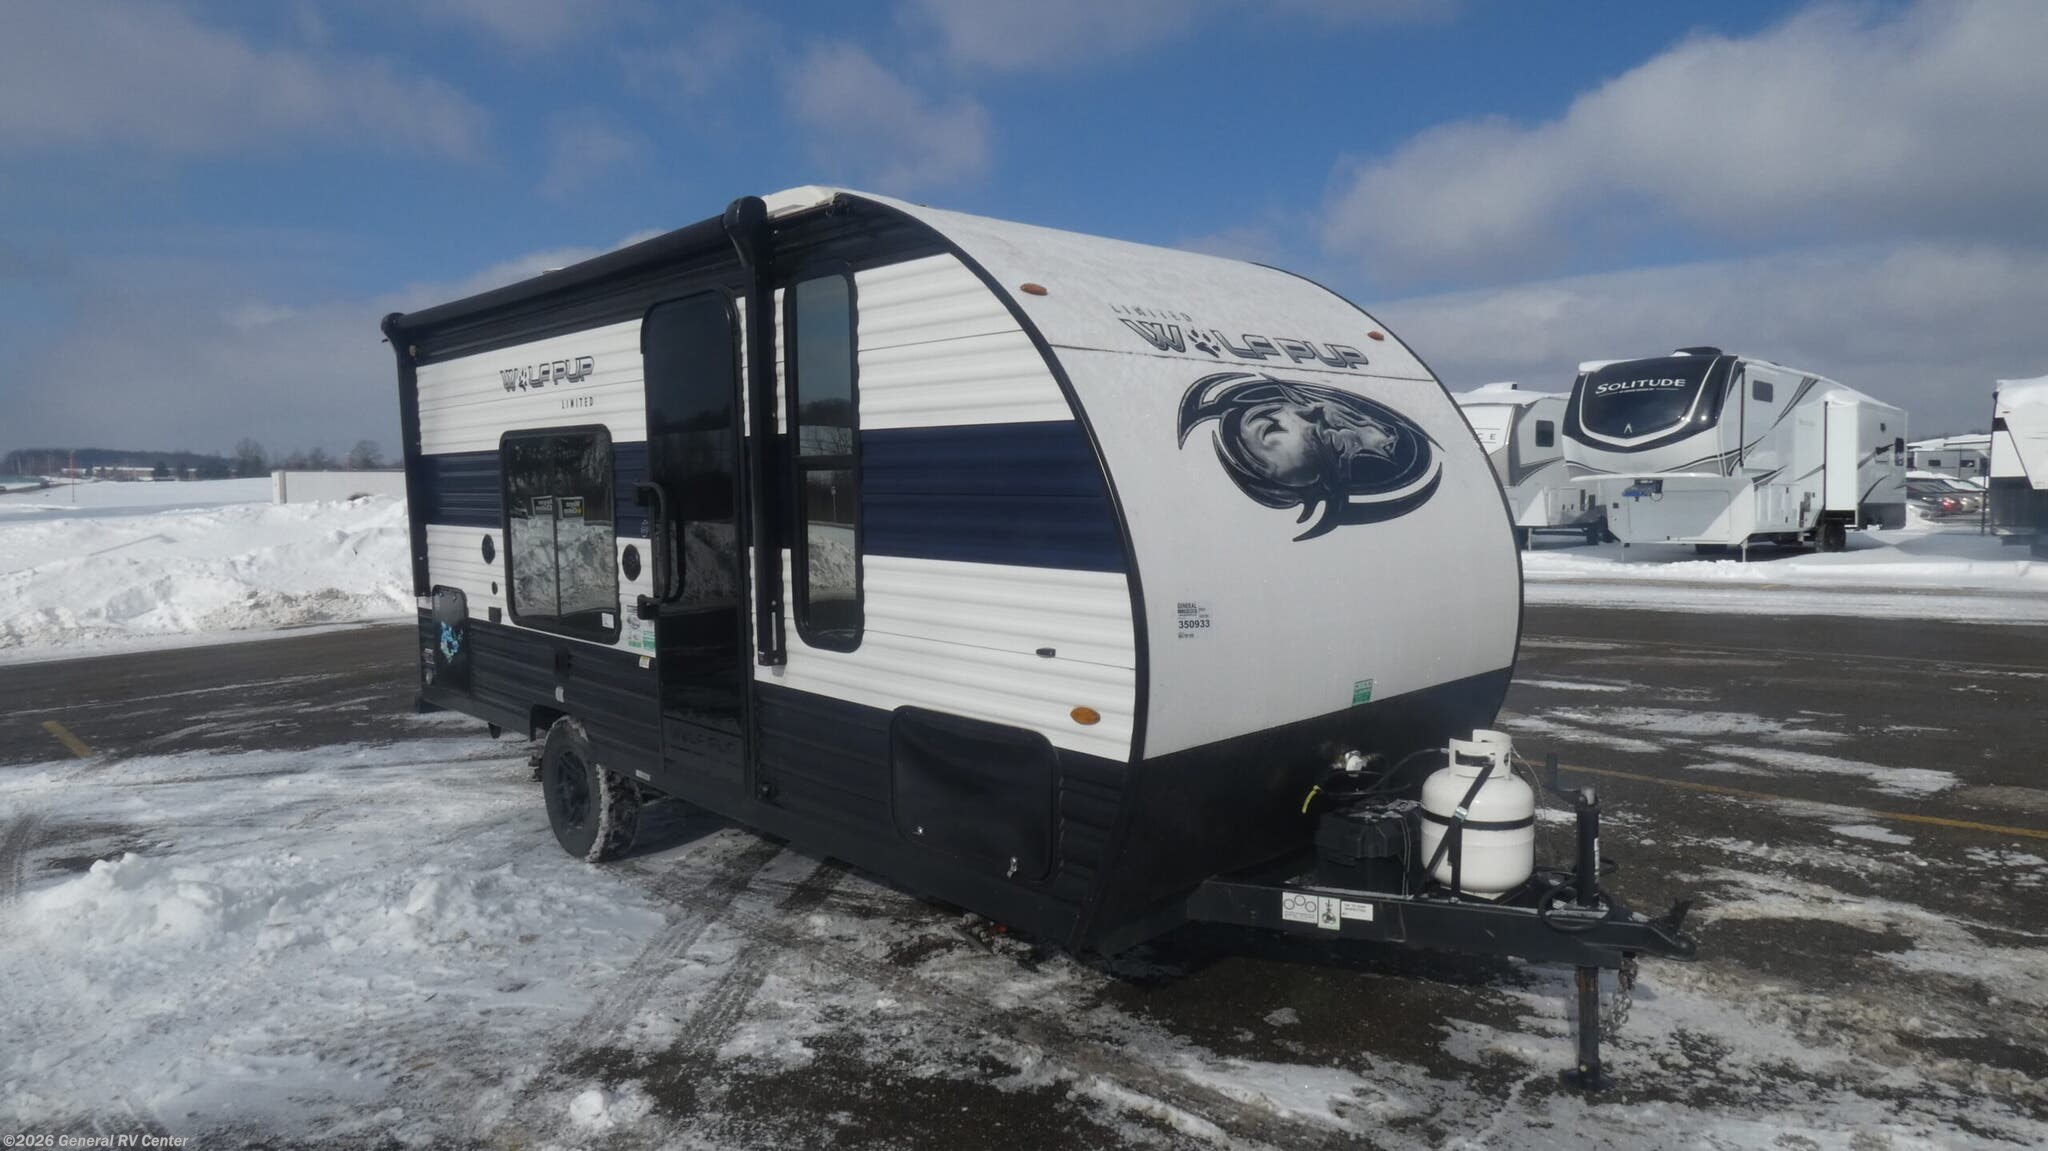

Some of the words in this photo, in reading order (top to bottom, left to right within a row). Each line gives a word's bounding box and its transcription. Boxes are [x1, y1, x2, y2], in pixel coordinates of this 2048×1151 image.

[1108, 302, 1192, 322] LIMITED
[1595, 378, 1687, 395] SOLITUDE
[561, 396, 594, 409] LIMITED
[1178, 619, 1211, 629] 350933
